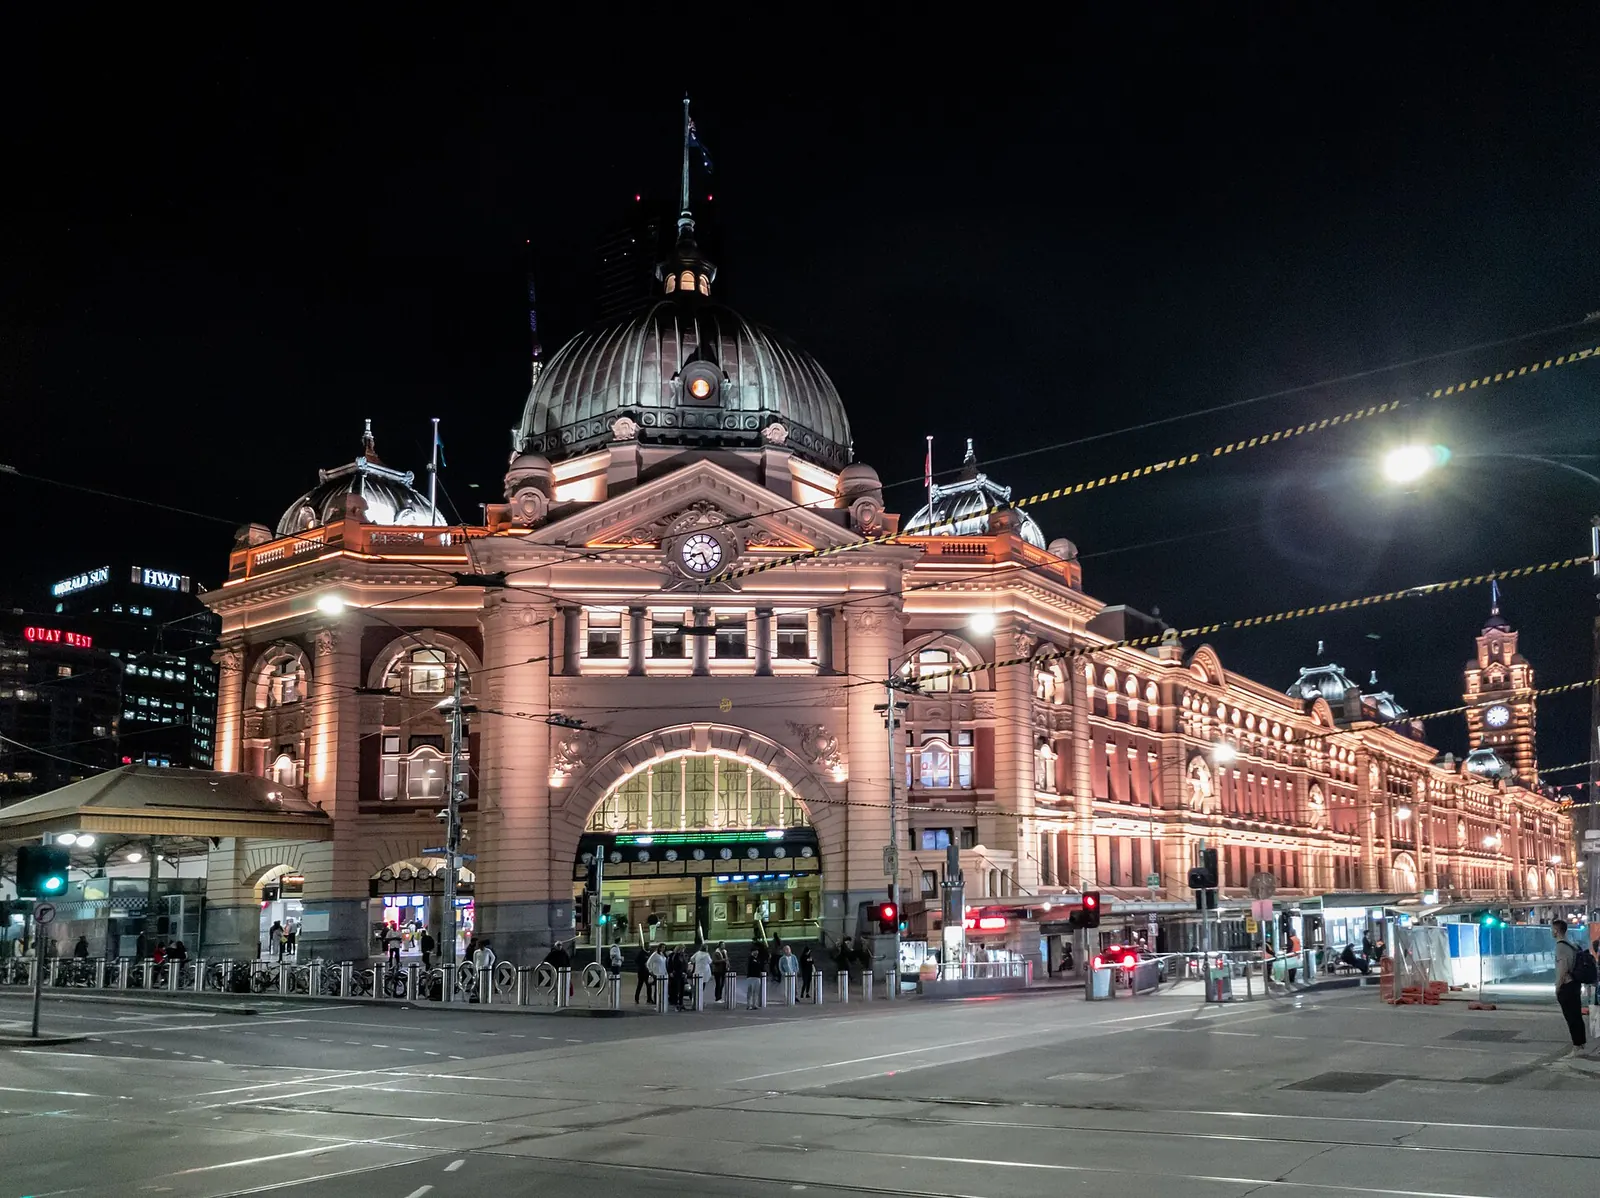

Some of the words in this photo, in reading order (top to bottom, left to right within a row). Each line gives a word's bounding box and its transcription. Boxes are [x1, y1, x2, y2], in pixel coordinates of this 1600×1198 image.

[90, 569, 108, 584] SUN
[144, 569, 181, 588] HWT
[28, 627, 61, 642] QUAY
[67, 632, 92, 648] WEST
